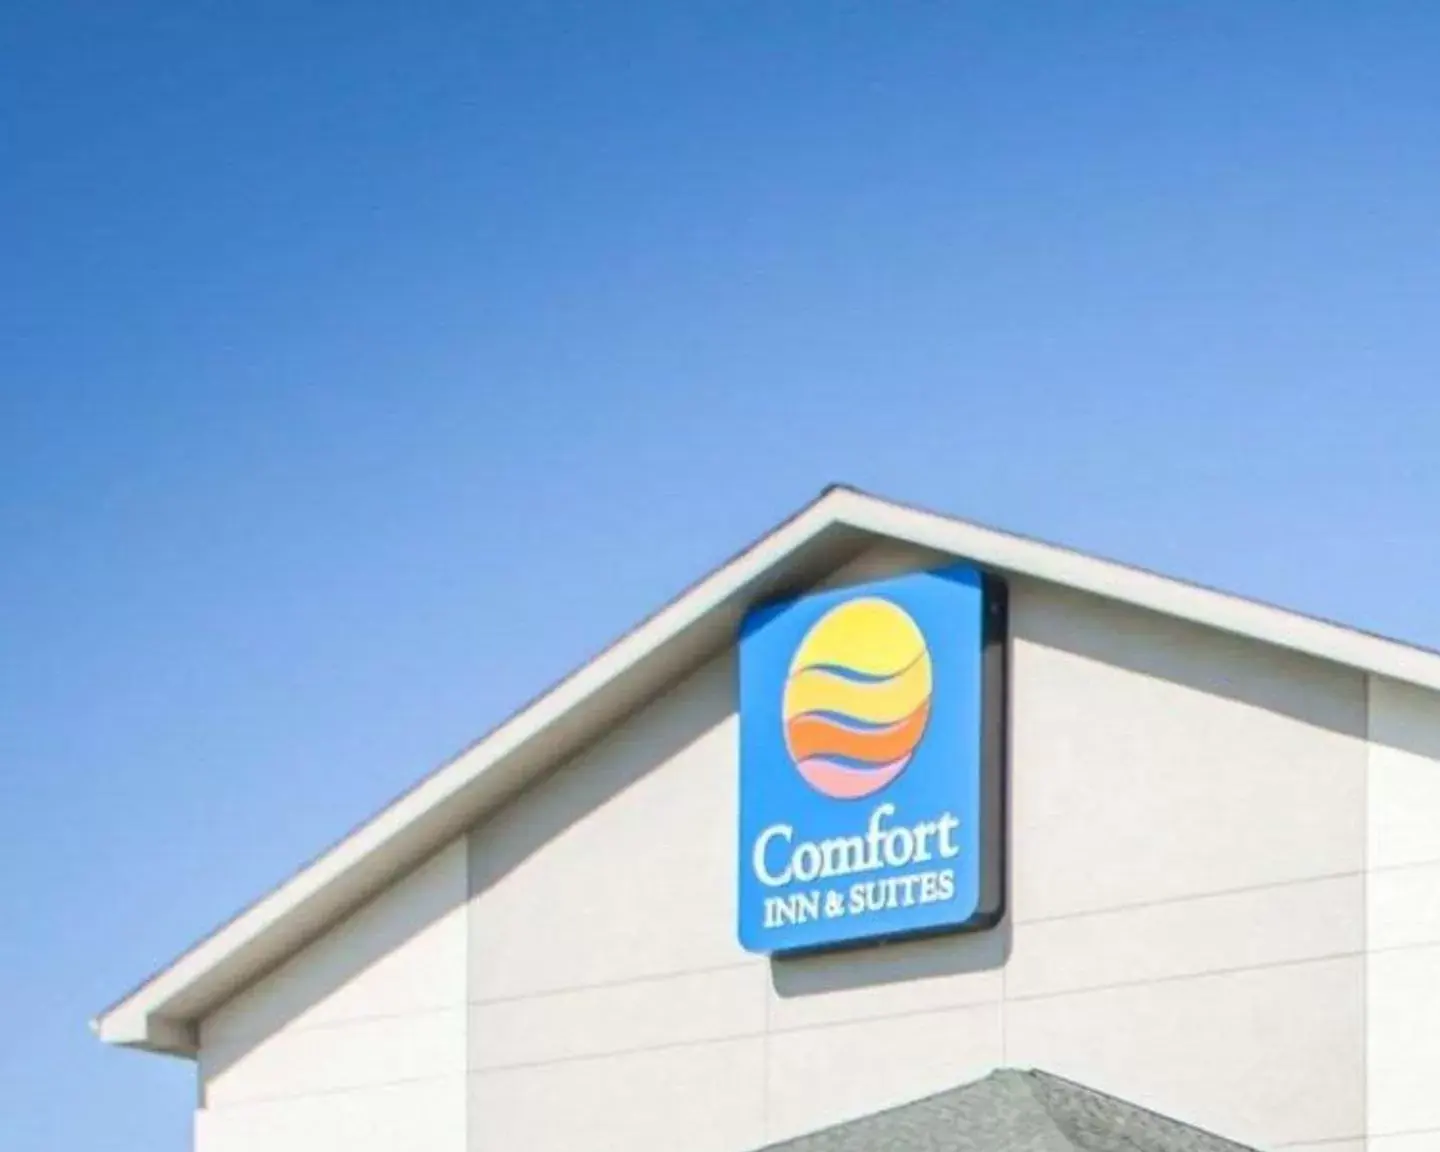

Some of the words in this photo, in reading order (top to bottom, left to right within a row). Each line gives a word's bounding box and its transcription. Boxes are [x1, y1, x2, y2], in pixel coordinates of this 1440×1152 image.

[752, 803, 960, 887] Comfort
[763, 890, 820, 929] INN
[824, 889, 845, 919] &
[850, 868, 955, 916] SUITES
